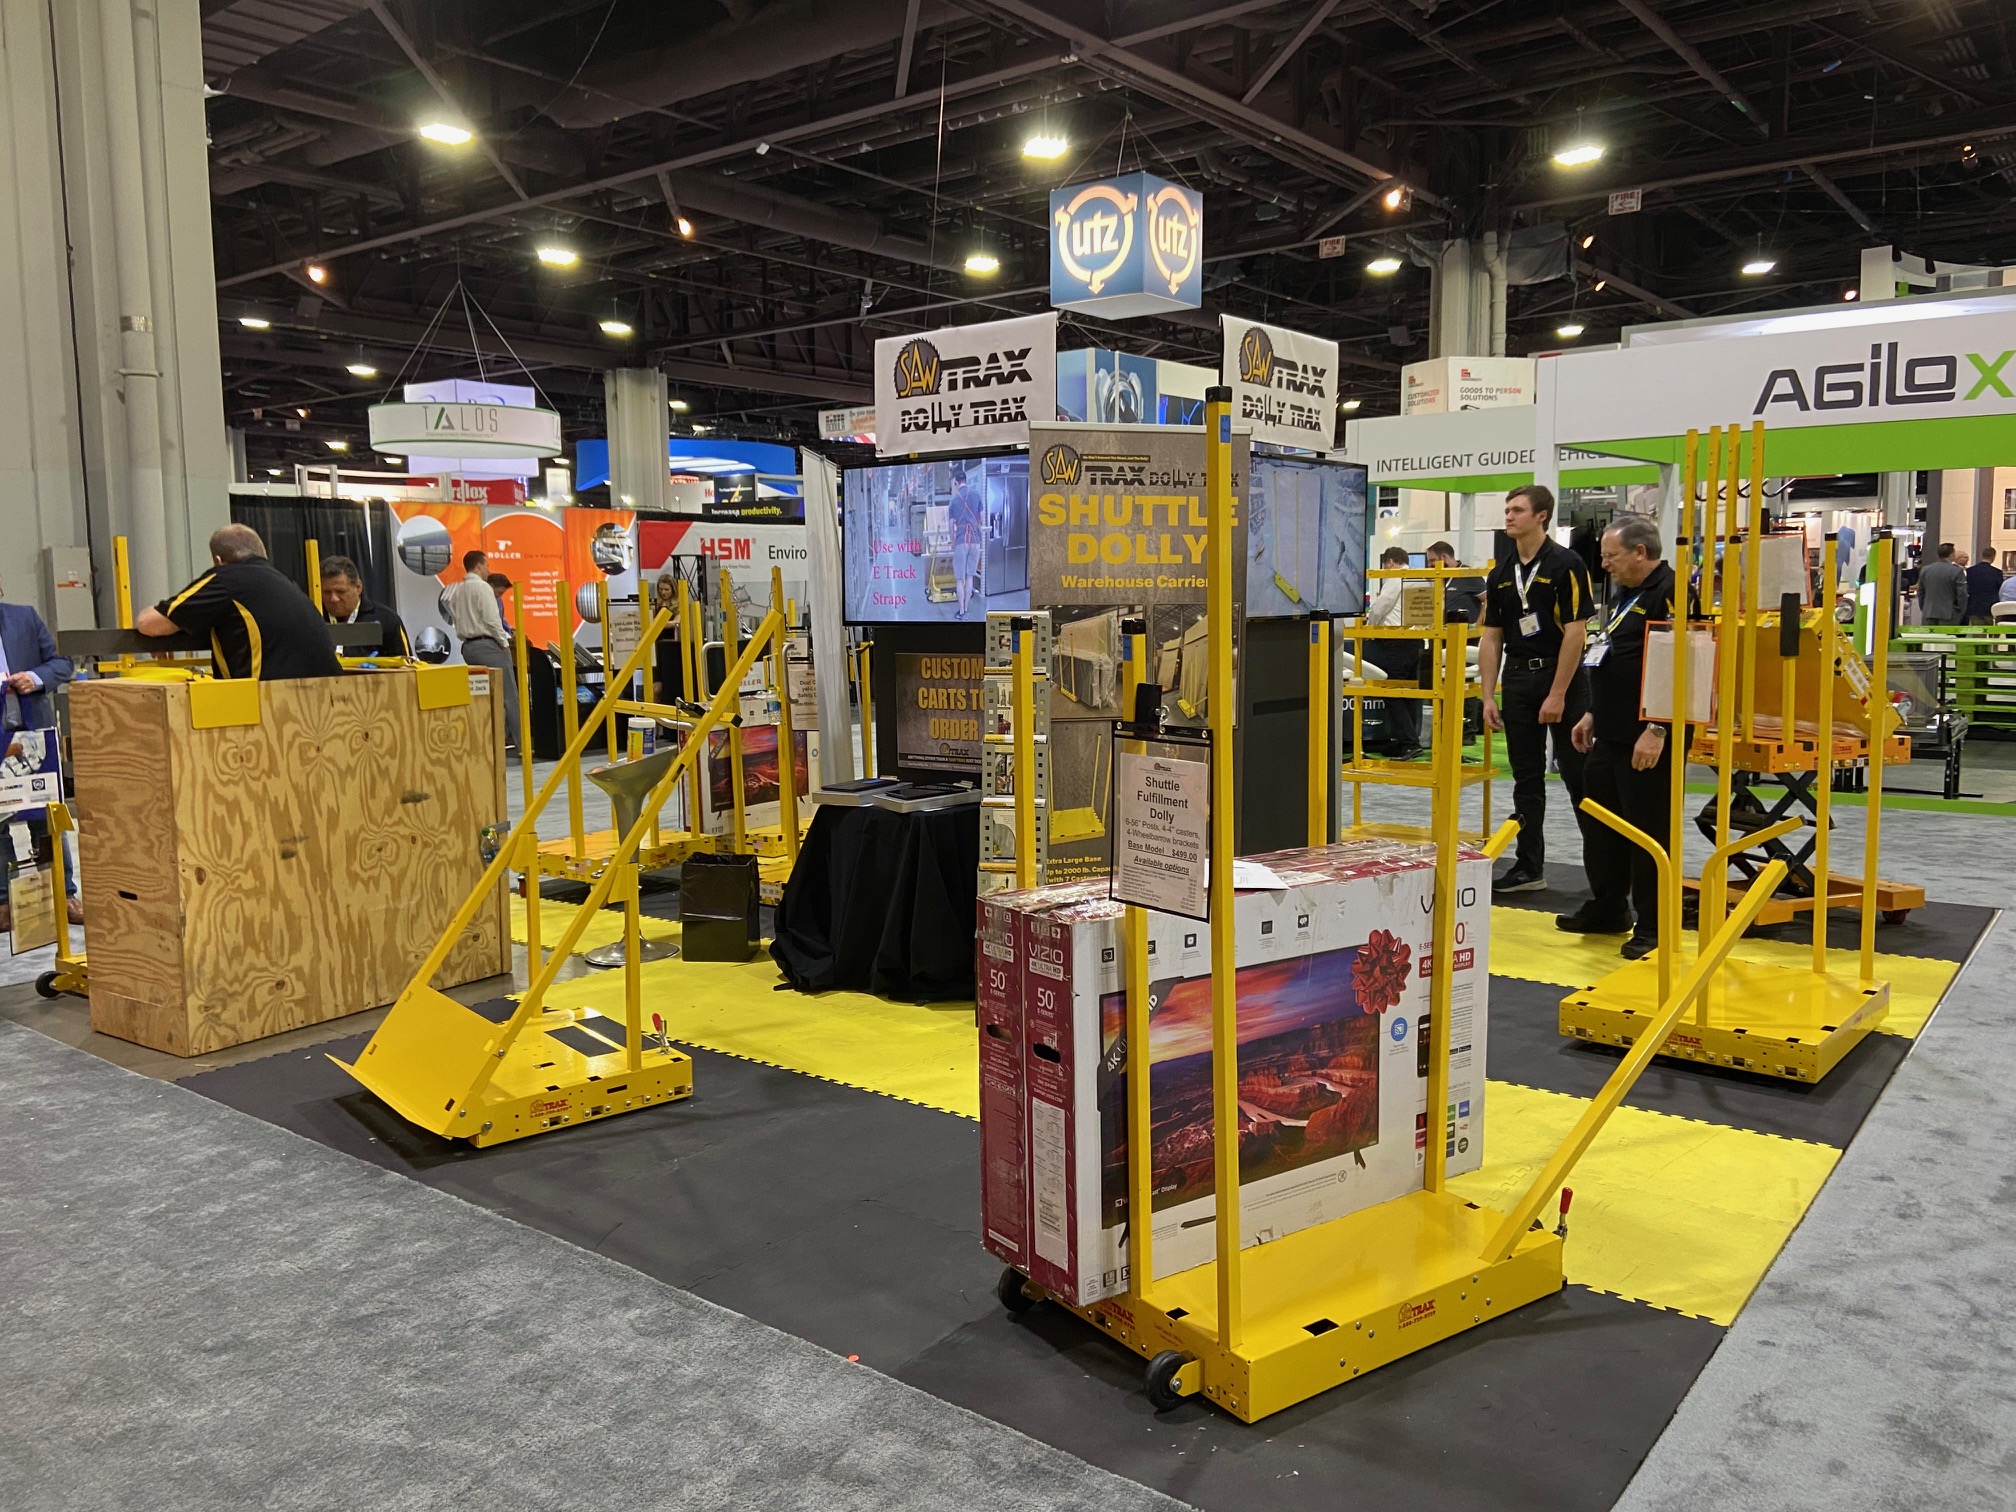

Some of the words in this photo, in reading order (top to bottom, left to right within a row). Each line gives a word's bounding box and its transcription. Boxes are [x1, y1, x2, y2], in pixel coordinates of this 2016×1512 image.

[1072, 210, 1119, 256] utz
[1159, 214, 1188, 259] utz
[900, 343, 938, 397] SAW
[939, 347, 1033, 392] TRAX
[1242, 333, 1272, 383] SAW
[1273, 356, 1327, 398] TRAX
[970, 396, 1028, 426] TRAX
[1407, 397, 1436, 407] SOLUTIONS
[422, 406, 498, 432] TALOS
[1290, 404, 1322, 432] TRAX
[1046, 447, 1078, 485] SAW
[1085, 465, 1146, 486] TRAX
[1376, 453, 1474, 473] INTELLIGENT
[741, 506, 783, 516] productivity.
[1038, 493, 1239, 527] SHUTTLE
[487, 551, 521, 559] ROLLER
[873, 539, 894, 554] Use
[897, 539, 923, 553] with
[1068, 533, 1208, 565] DOLLY
[873, 565, 880, 579] E
[884, 564, 916, 579] Track
[1061, 575, 1154, 588] Warehouse
[873, 591, 907, 609] Straps
[921, 657, 985, 680] CUSTOM
[917, 687, 967, 711] CARTS
[929, 717, 979, 741] ORDER
[1145, 776, 1180, 792] Shuttle
[1137, 790, 1189, 809] Fulfillment
[1149, 807, 1175, 825] Dolly
[1126, 828, 1171, 844] 4-Wheelbarrow
[1172, 834, 1199, 850] brackets
[1175, 827, 1201, 841] casters,
[1128, 840, 1144, 851] Base
[1144, 844, 1165, 855] Model
[1171, 848, 1198, 862] $499.00
[1134, 855, 1164, 869] Available
[1164, 860, 1190, 875] options
[1046, 876, 1064, 884] (with
[1421, 887, 1476, 914] VIO
[1028, 942, 1064, 964] VIZIO
[1459, 952, 1471, 963] HD
[1038, 962, 1052, 972] ULTRA
[1678, 1034, 1703, 1045] TRAX
[1107, 1052, 1121, 1072] 4K
[543, 1098, 569, 1111] TRAX
[1411, 1299, 1435, 1316] TRAX
